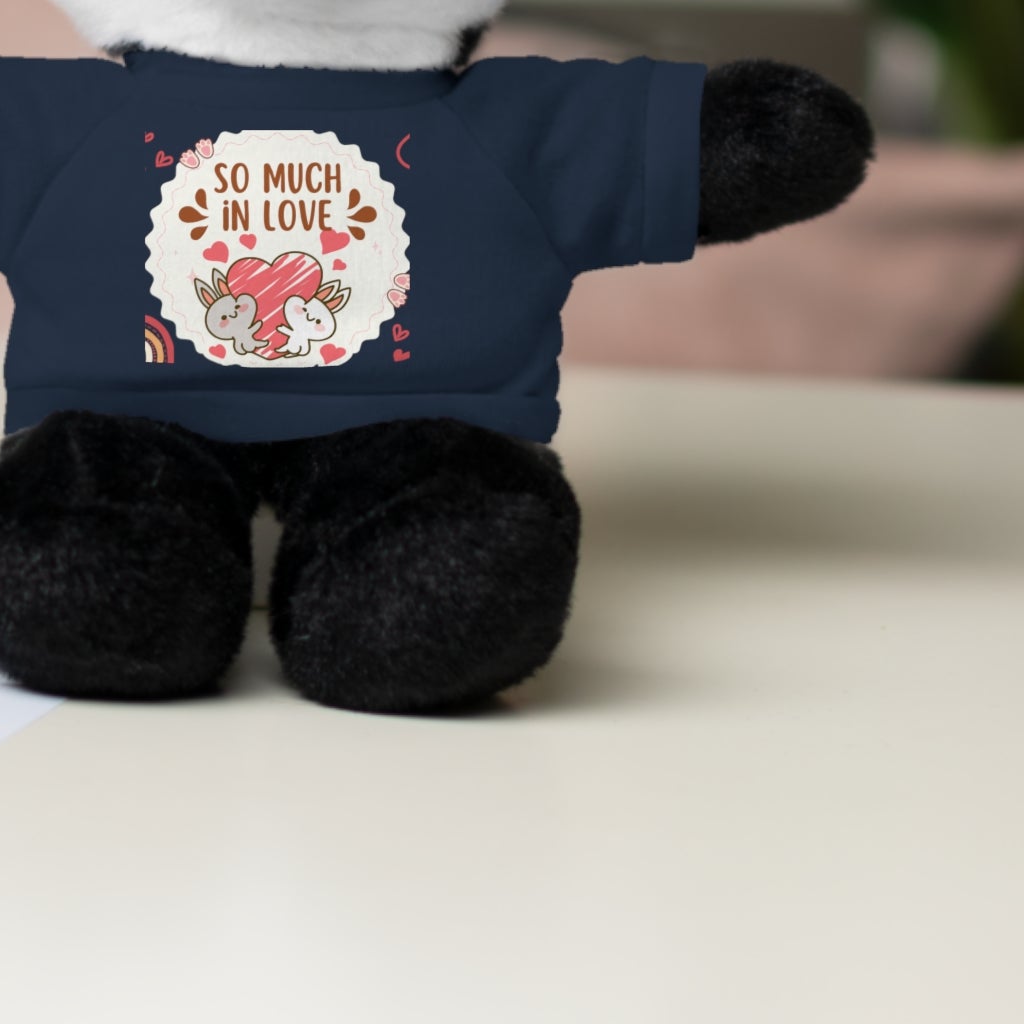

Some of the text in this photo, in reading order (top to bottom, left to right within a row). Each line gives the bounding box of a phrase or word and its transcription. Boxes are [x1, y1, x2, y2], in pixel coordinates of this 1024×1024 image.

[214, 162, 342, 193] SO MUCH
[263, 200, 332, 231] LOVE
